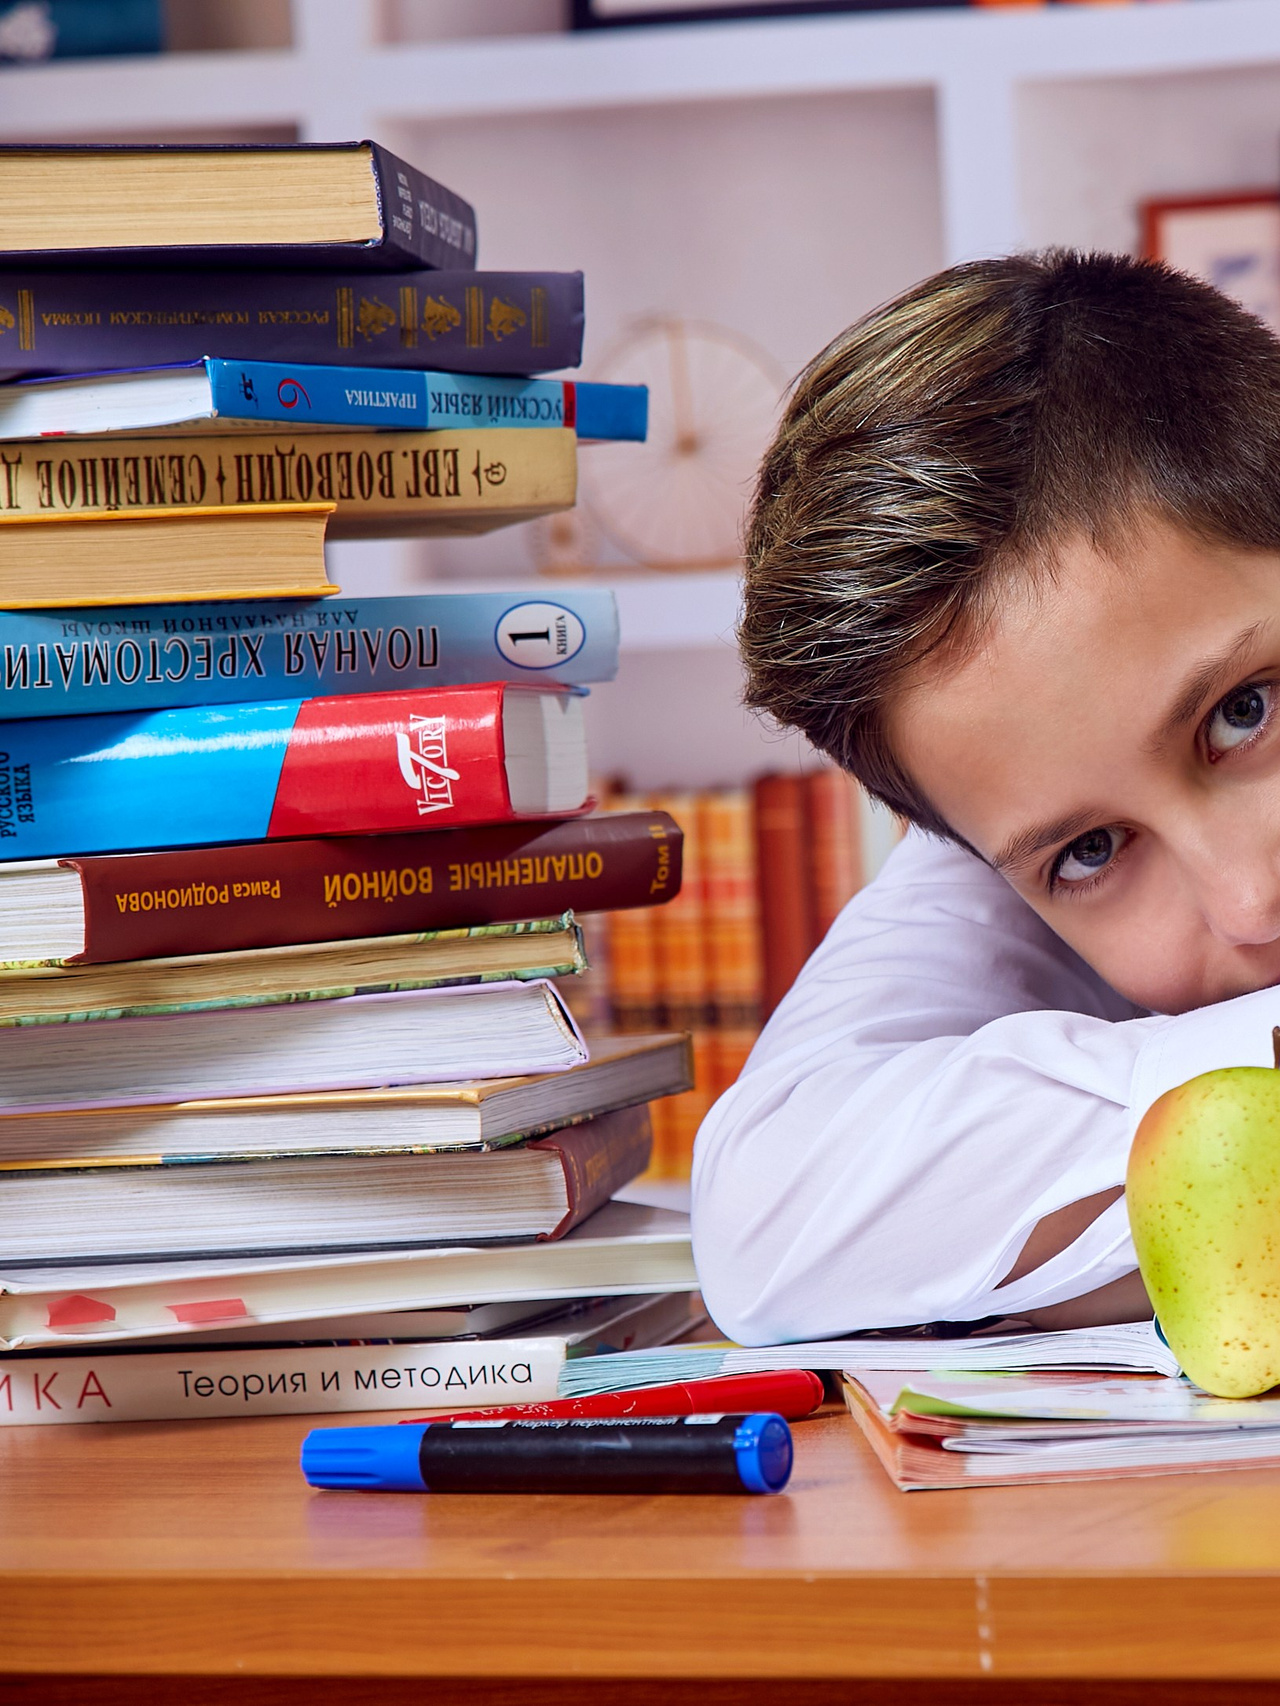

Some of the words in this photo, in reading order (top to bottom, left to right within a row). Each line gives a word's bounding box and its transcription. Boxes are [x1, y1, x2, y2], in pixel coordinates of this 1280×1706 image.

[259, 310, 330, 325] РУССКАЯ
[344, 389, 417, 410] ПРАКТИКА
[430, 391, 483, 415] ЯЗЫК
[0, 451, 22, 509] Д
[36, 454, 207, 511] СЕМЕЙНОЕ
[234, 444, 395, 503] ВОЕВОДИН
[402, 449, 461, 499] ЕВГ.
[61, 616, 151, 638] ШКОЛЫ
[163, 613, 306, 636] НАЧАЛЬНОЙ
[317, 609, 359, 626] ДЛЯ
[508, 627, 550, 647] 1
[0, 632, 267, 692] ХРЕСТОМАТИ
[284, 625, 439, 679] ПОЛНАЯ
[13, 763, 35, 823] ЯЗЫКА
[233, 879, 281, 900] Раиса
[323, 865, 434, 908] ВОЙНОЙ
[450, 850, 603, 892] ОПАЛЕННЫЕ
[115, 883, 229, 914] РОДИОНОВА
[178, 1369, 307, 1401] Теория
[321, 1371, 341, 1392] и
[354, 1361, 534, 1391] методика
